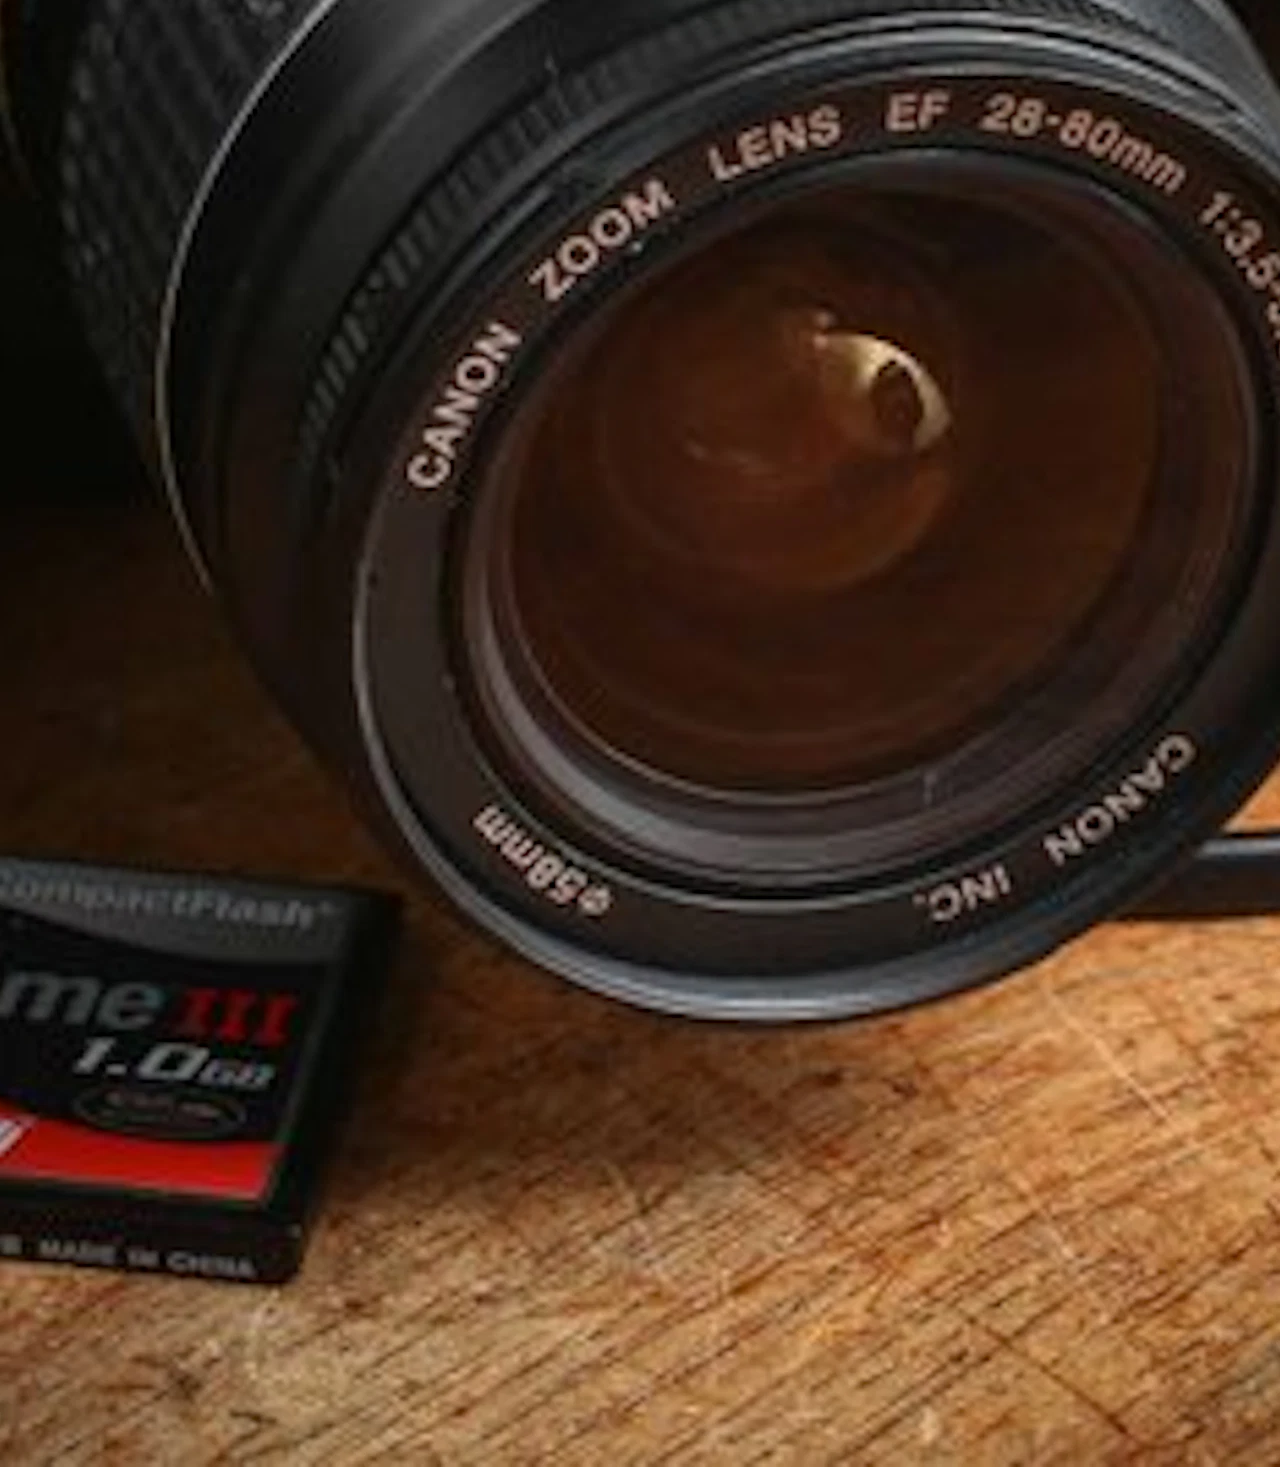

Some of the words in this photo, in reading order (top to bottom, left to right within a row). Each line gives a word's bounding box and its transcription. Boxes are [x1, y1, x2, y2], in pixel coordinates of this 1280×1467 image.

[407, 322, 521, 492] CANON
[530, 177, 675, 303] ZOOM
[708, 104, 842, 184] LENS
[884, 91, 950, 132] EF
[980, 93, 1186, 196] 28-80mm
[1042, 732, 1197, 869] CANON
[912, 864, 1011, 923] INC.
[175, 988, 297, 1047] III
[71, 1035, 278, 1092] 1.0GB
